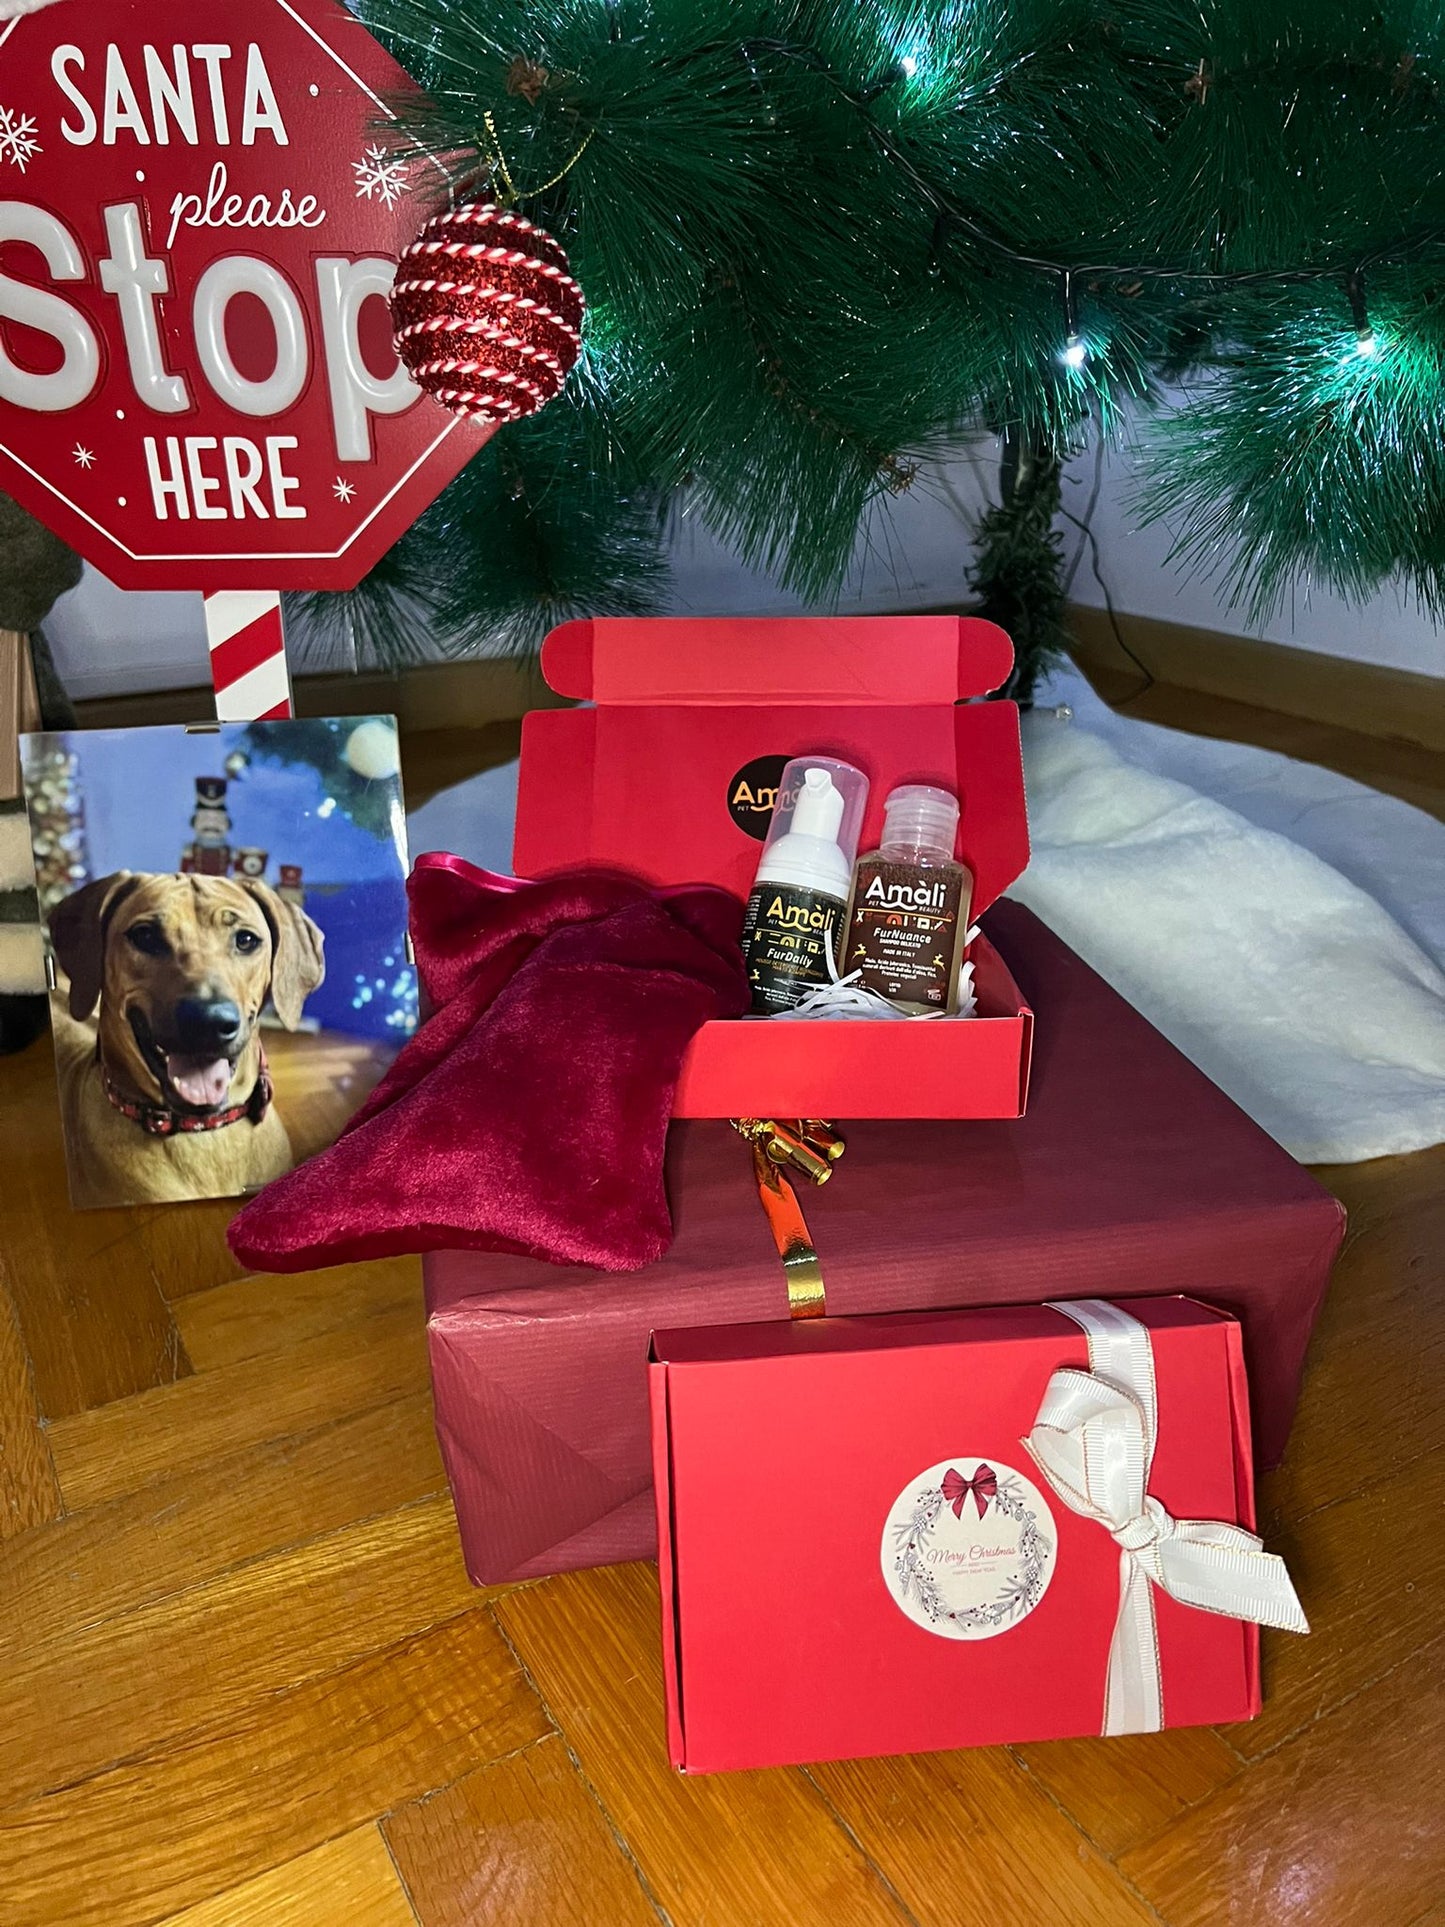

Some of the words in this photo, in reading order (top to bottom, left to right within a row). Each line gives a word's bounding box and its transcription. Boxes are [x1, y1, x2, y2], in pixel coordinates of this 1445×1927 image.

[50, 43, 289, 146] SANTA
[166, 162, 326, 250] please
[0, 201, 422, 463] Stop
[143, 436, 307, 520] HERE
[865, 875, 946, 911] Amàli
[918, 905, 942, 914] BEAUTY
[766, 895, 836, 932] Amàli
[873, 927, 932, 944] FurNuance
[902, 950, 916, 958] ITALY
[926, 1548, 967, 1566] Merry
[969, 1544, 1016, 1561] Christmas
